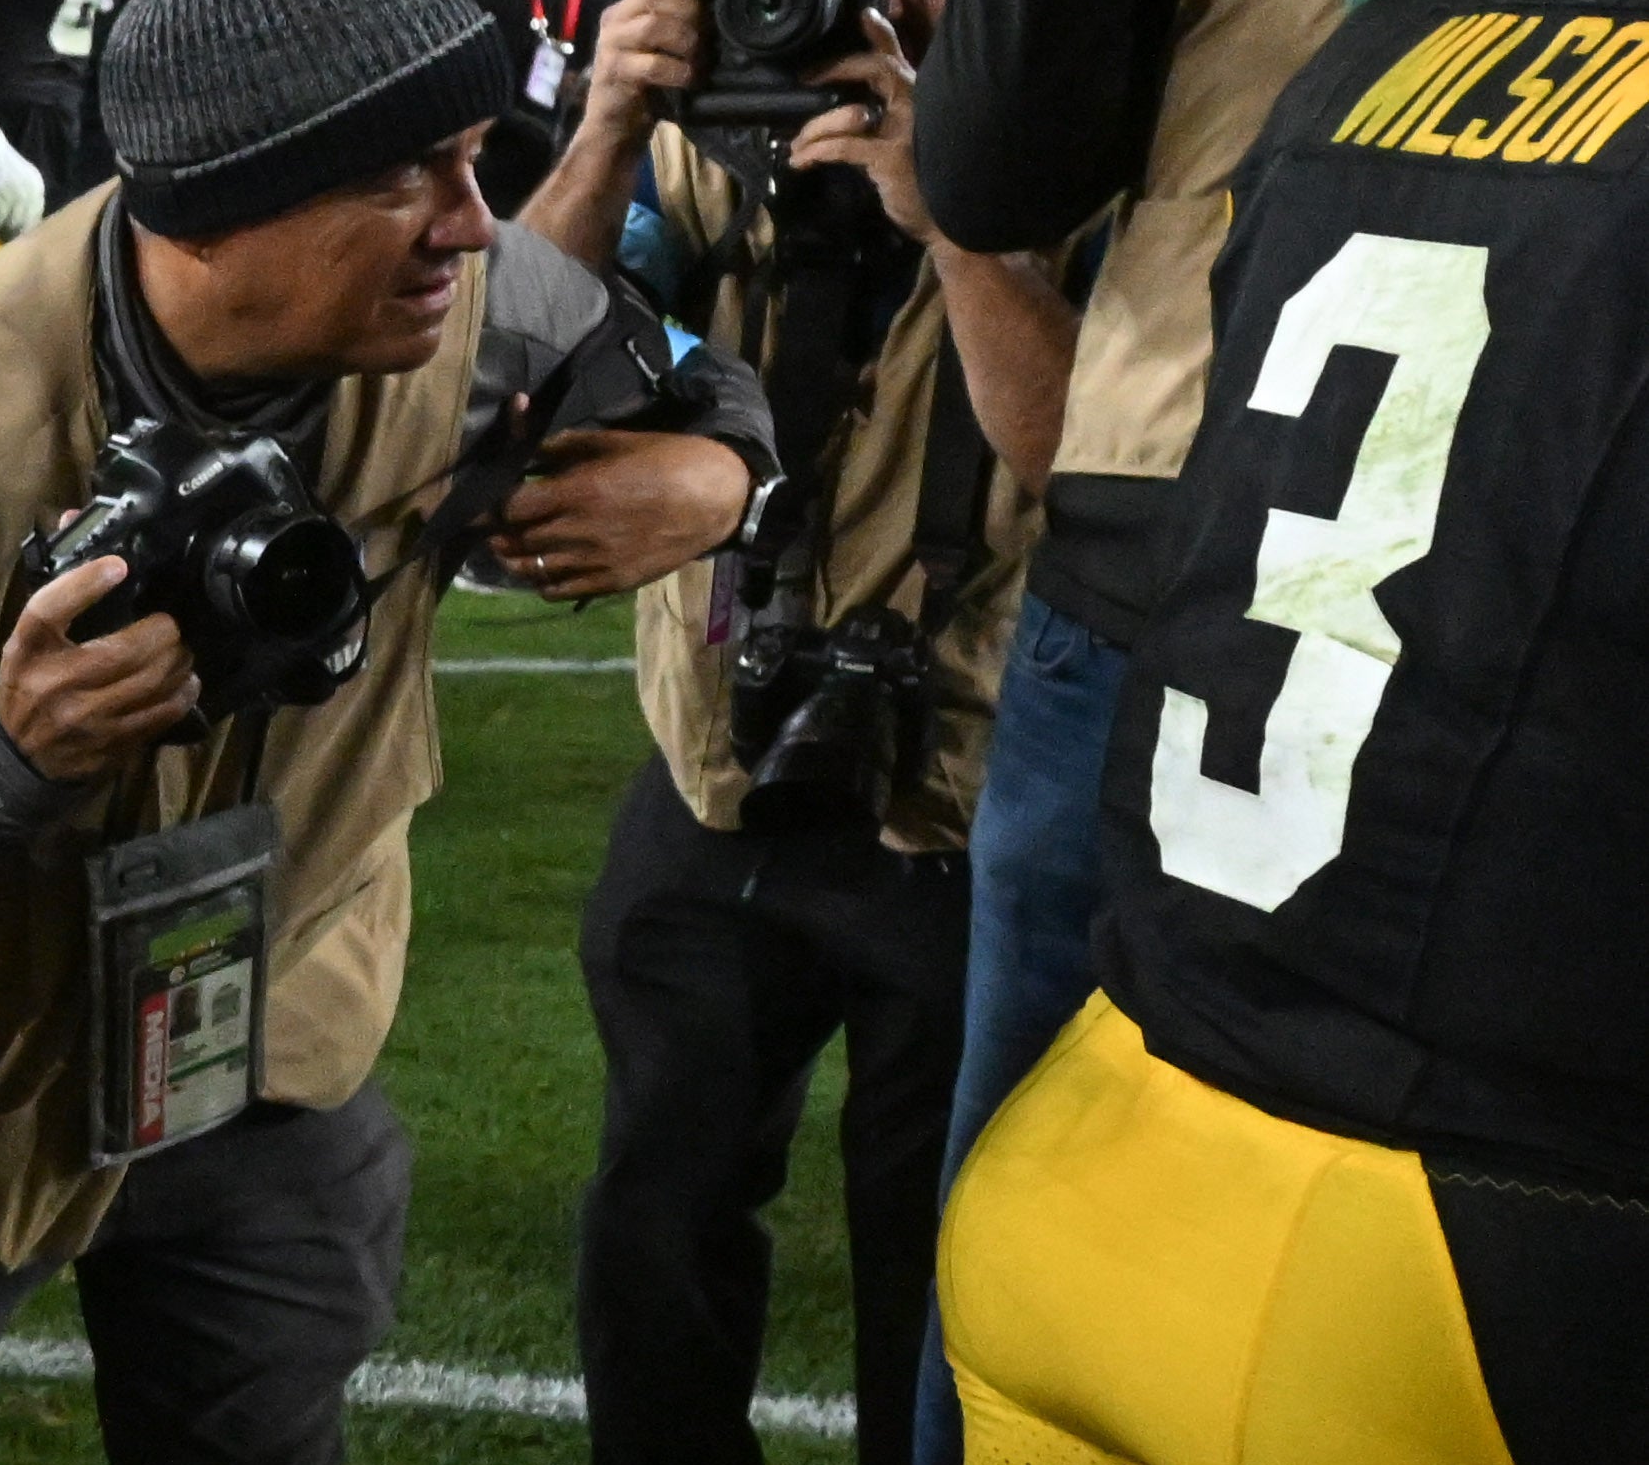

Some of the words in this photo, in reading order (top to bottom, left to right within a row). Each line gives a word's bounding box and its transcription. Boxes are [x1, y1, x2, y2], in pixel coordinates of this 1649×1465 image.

[178, 460, 224, 497] Canon
[1149, 232, 1491, 913] 3
[142, 1010, 165, 1128] MEDIA
